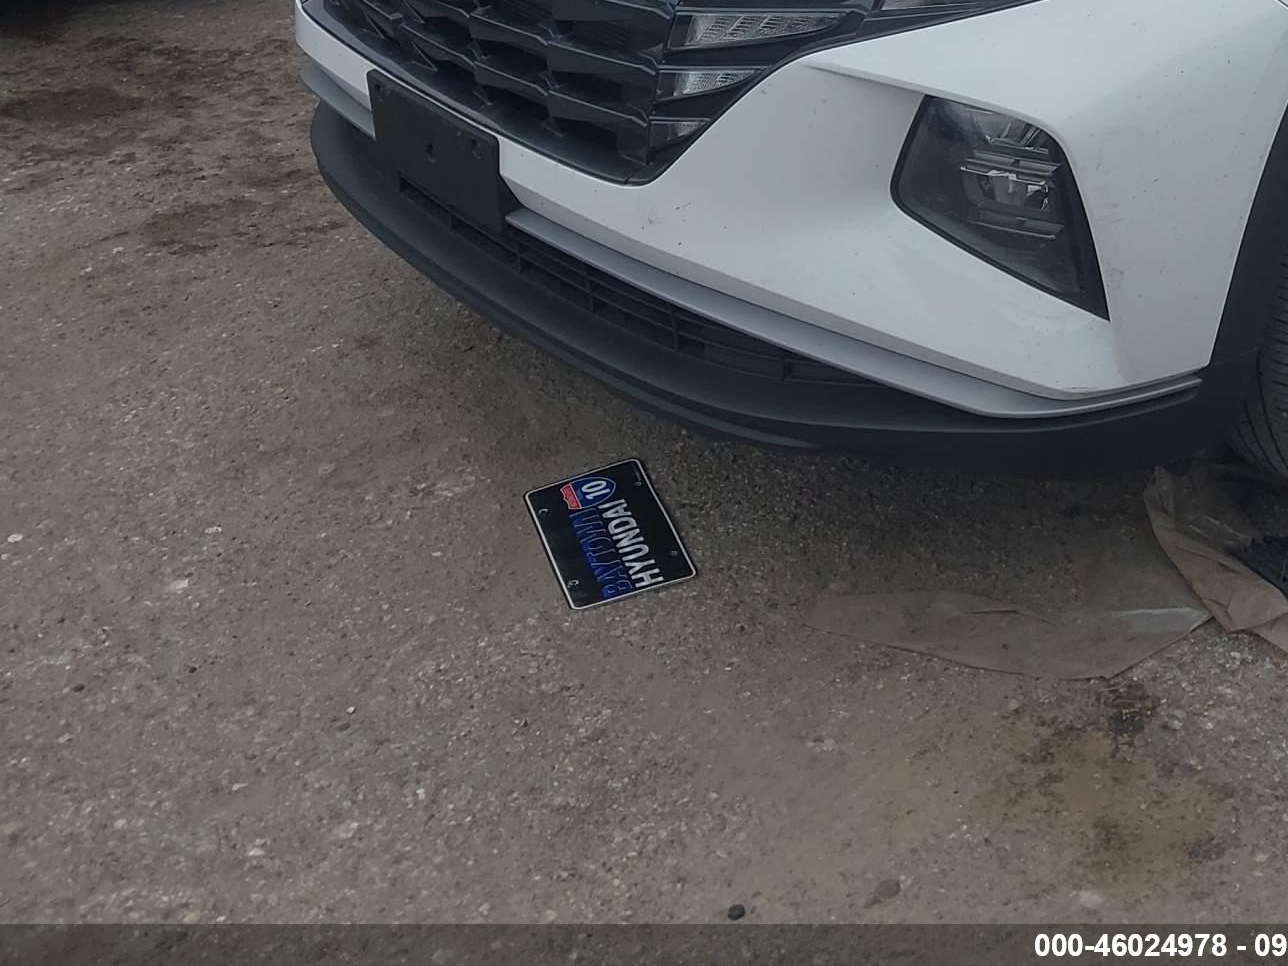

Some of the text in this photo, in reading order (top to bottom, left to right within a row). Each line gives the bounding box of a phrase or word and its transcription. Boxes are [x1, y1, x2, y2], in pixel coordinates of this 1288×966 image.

[581, 480, 611, 500] 10
[568, 507, 634, 598] BAYTOWN
[598, 498, 664, 588] HYUNDAI
